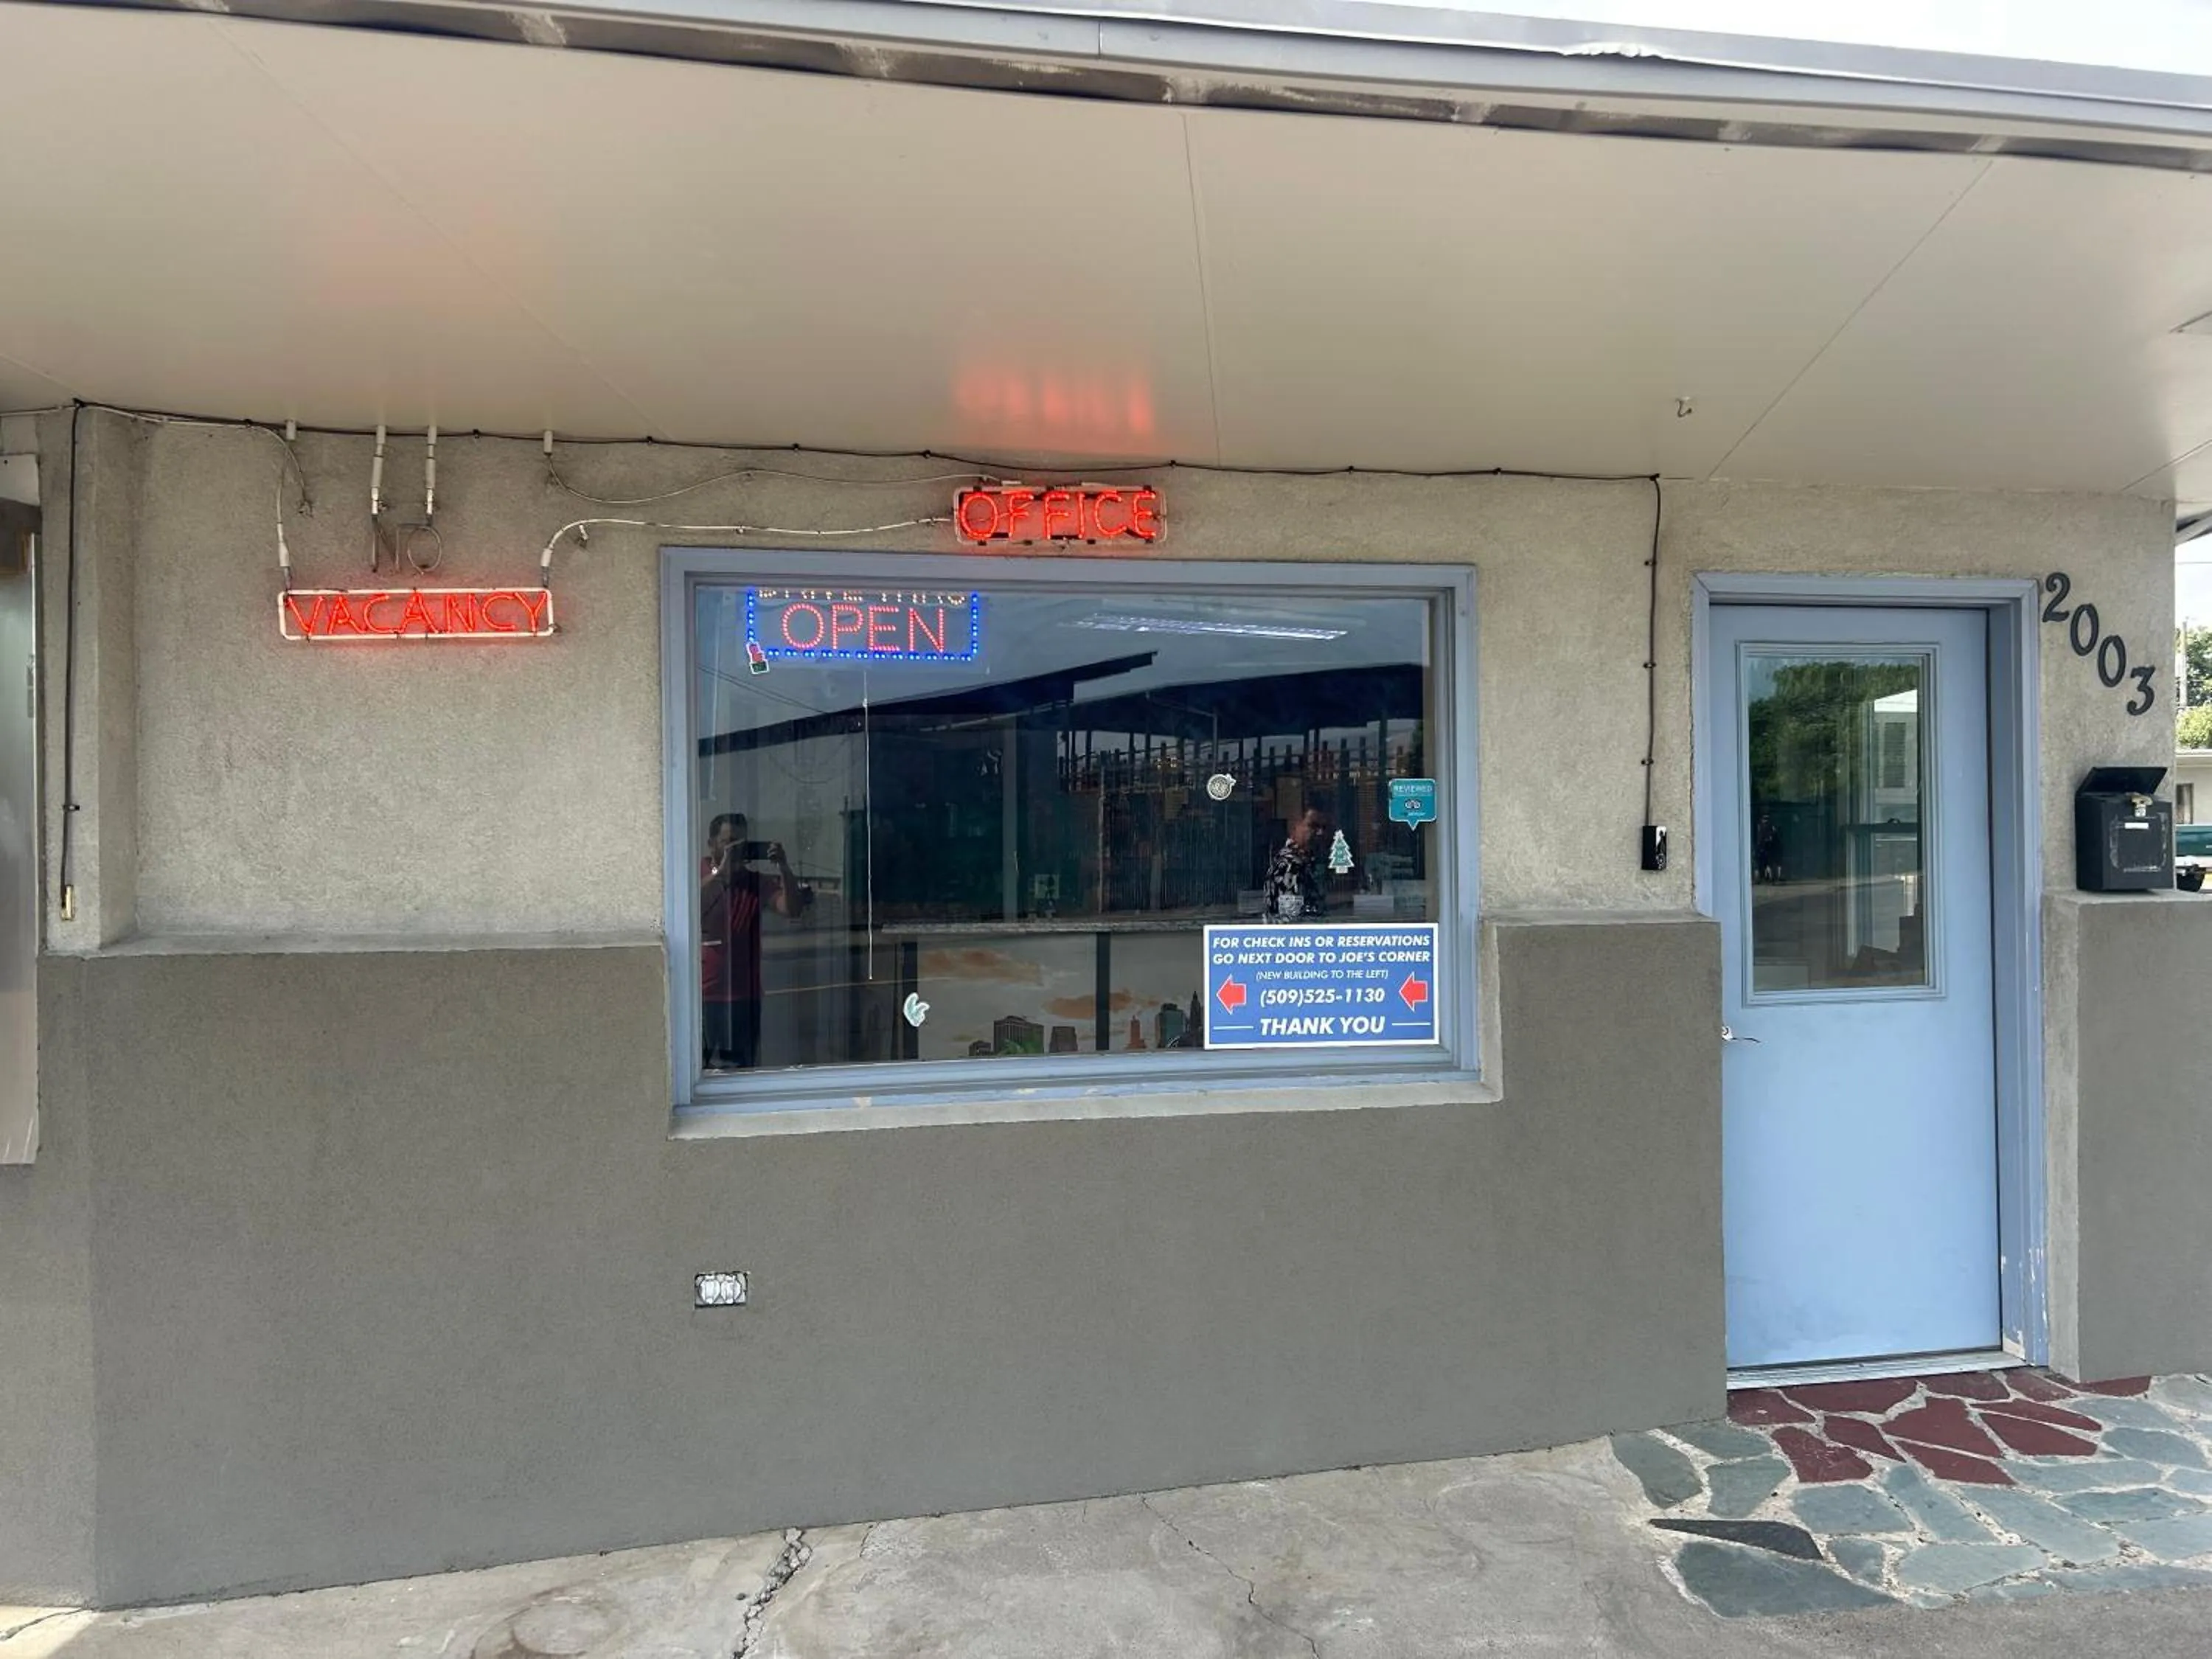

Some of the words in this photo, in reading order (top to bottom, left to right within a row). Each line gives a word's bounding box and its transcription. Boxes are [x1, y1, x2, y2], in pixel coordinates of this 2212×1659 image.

[959, 491, 1156, 539] OFFICE
[372, 518, 442, 574] NO
[285, 591, 548, 636] VACANCY
[782, 602, 945, 653] OPEN
[2042, 571, 2156, 716] 2003
[1213, 937, 1239, 948] FOR
[1243, 936, 1286, 948] CHECK
[1289, 936, 1312, 947] INS
[1315, 936, 1334, 947] OR
[1338, 935, 1430, 947] RESERVATIONS
[1213, 953, 1234, 964] GO
[1237, 953, 1273, 964] NEXT
[1276, 952, 1315, 964] DOOR
[1318, 952, 1336, 964] TO
[1339, 952, 1375, 963] JOE'S
[1378, 951, 1430, 962] CORNER
[1256, 970, 1282, 982] (NEW
[1284, 970, 1329, 979] BUILDING
[1331, 970, 1344, 978] TO
[1346, 970, 1363, 978] THE
[1366, 969, 1389, 980] LEFT)
[1260, 988, 1385, 1007] (509)525-1130
[1260, 1017, 1335, 1036] THANK
[1339, 1016, 1386, 1034] YOU
